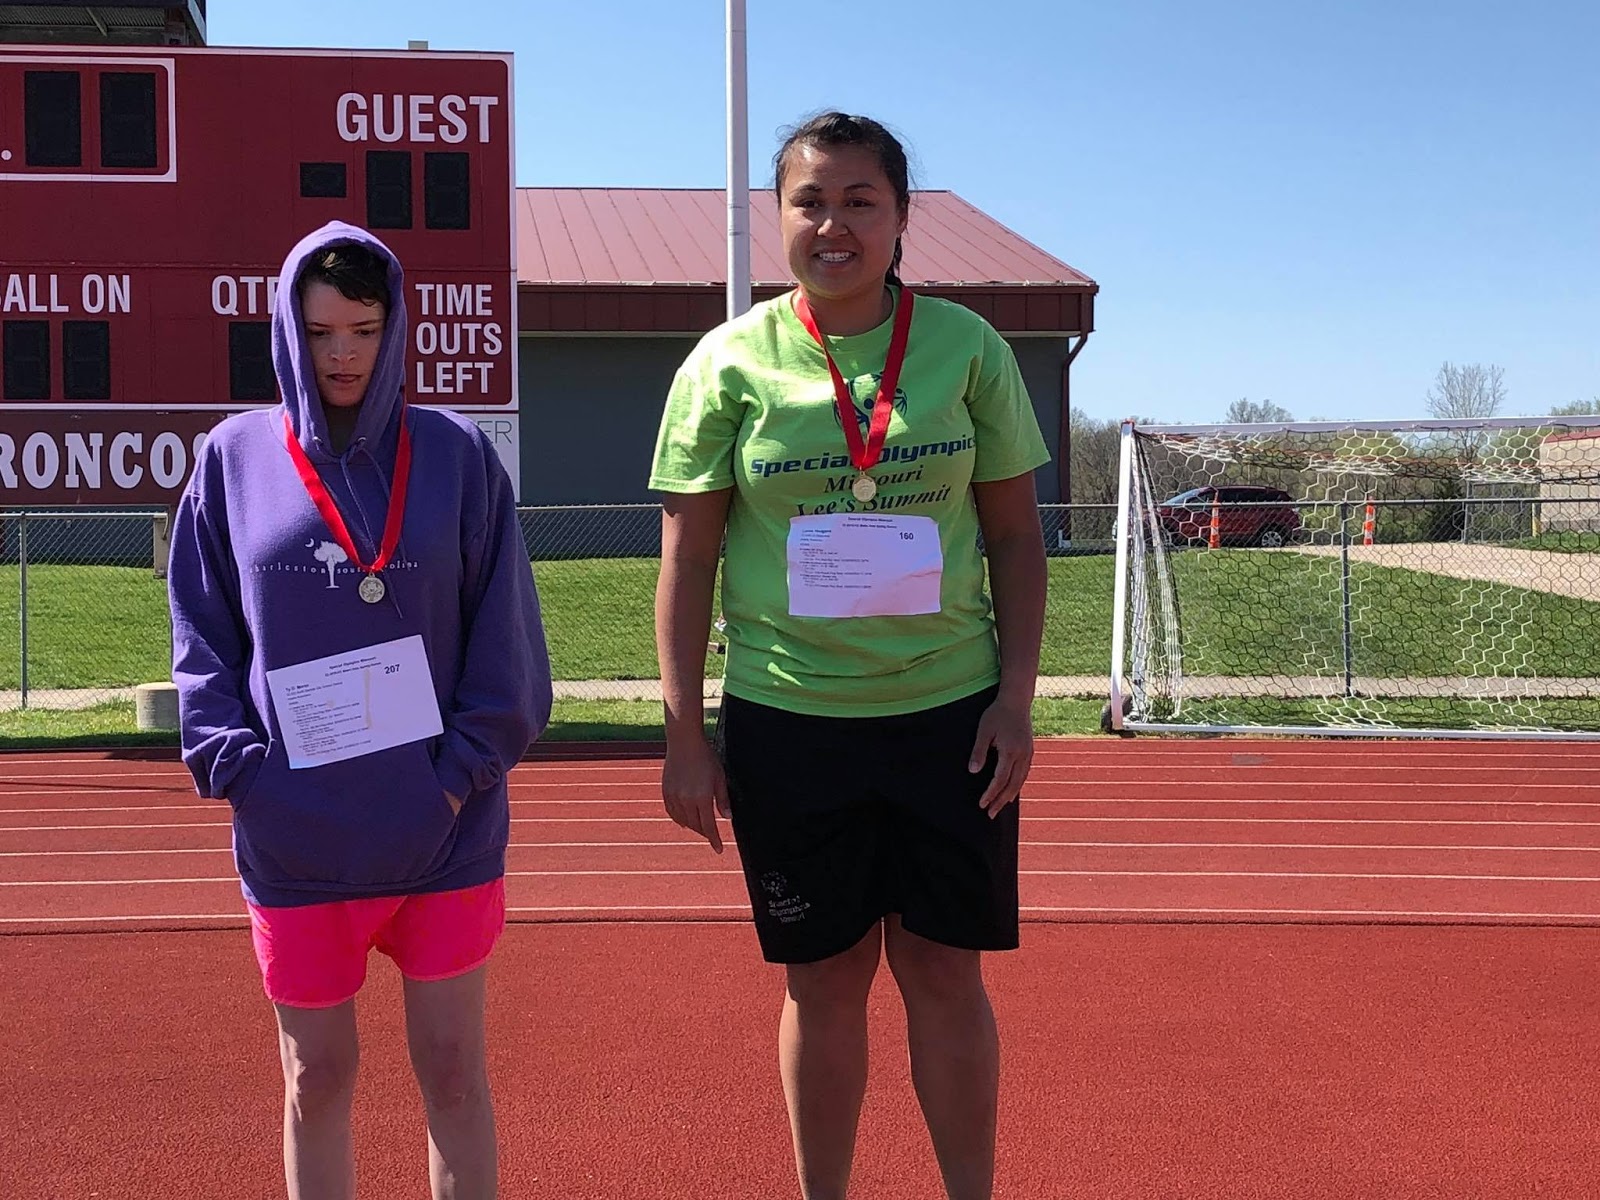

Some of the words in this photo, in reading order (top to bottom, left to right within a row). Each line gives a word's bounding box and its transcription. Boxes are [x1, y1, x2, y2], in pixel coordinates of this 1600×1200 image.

[337, 93, 498, 143] GUEST
[0, 274, 69, 312] ALL
[82, 274, 130, 313] ON
[415, 284, 492, 315] TIME
[416, 322, 502, 355] OUTS
[417, 362, 494, 393] LEFT
[750, 452, 854, 477] Specia
[874, 433, 976, 463] Olympic
[824, 465, 924, 493] Miouri
[797, 498, 855, 516] Lee's
[899, 532, 914, 540] 160
[384, 663, 400, 674] 207
